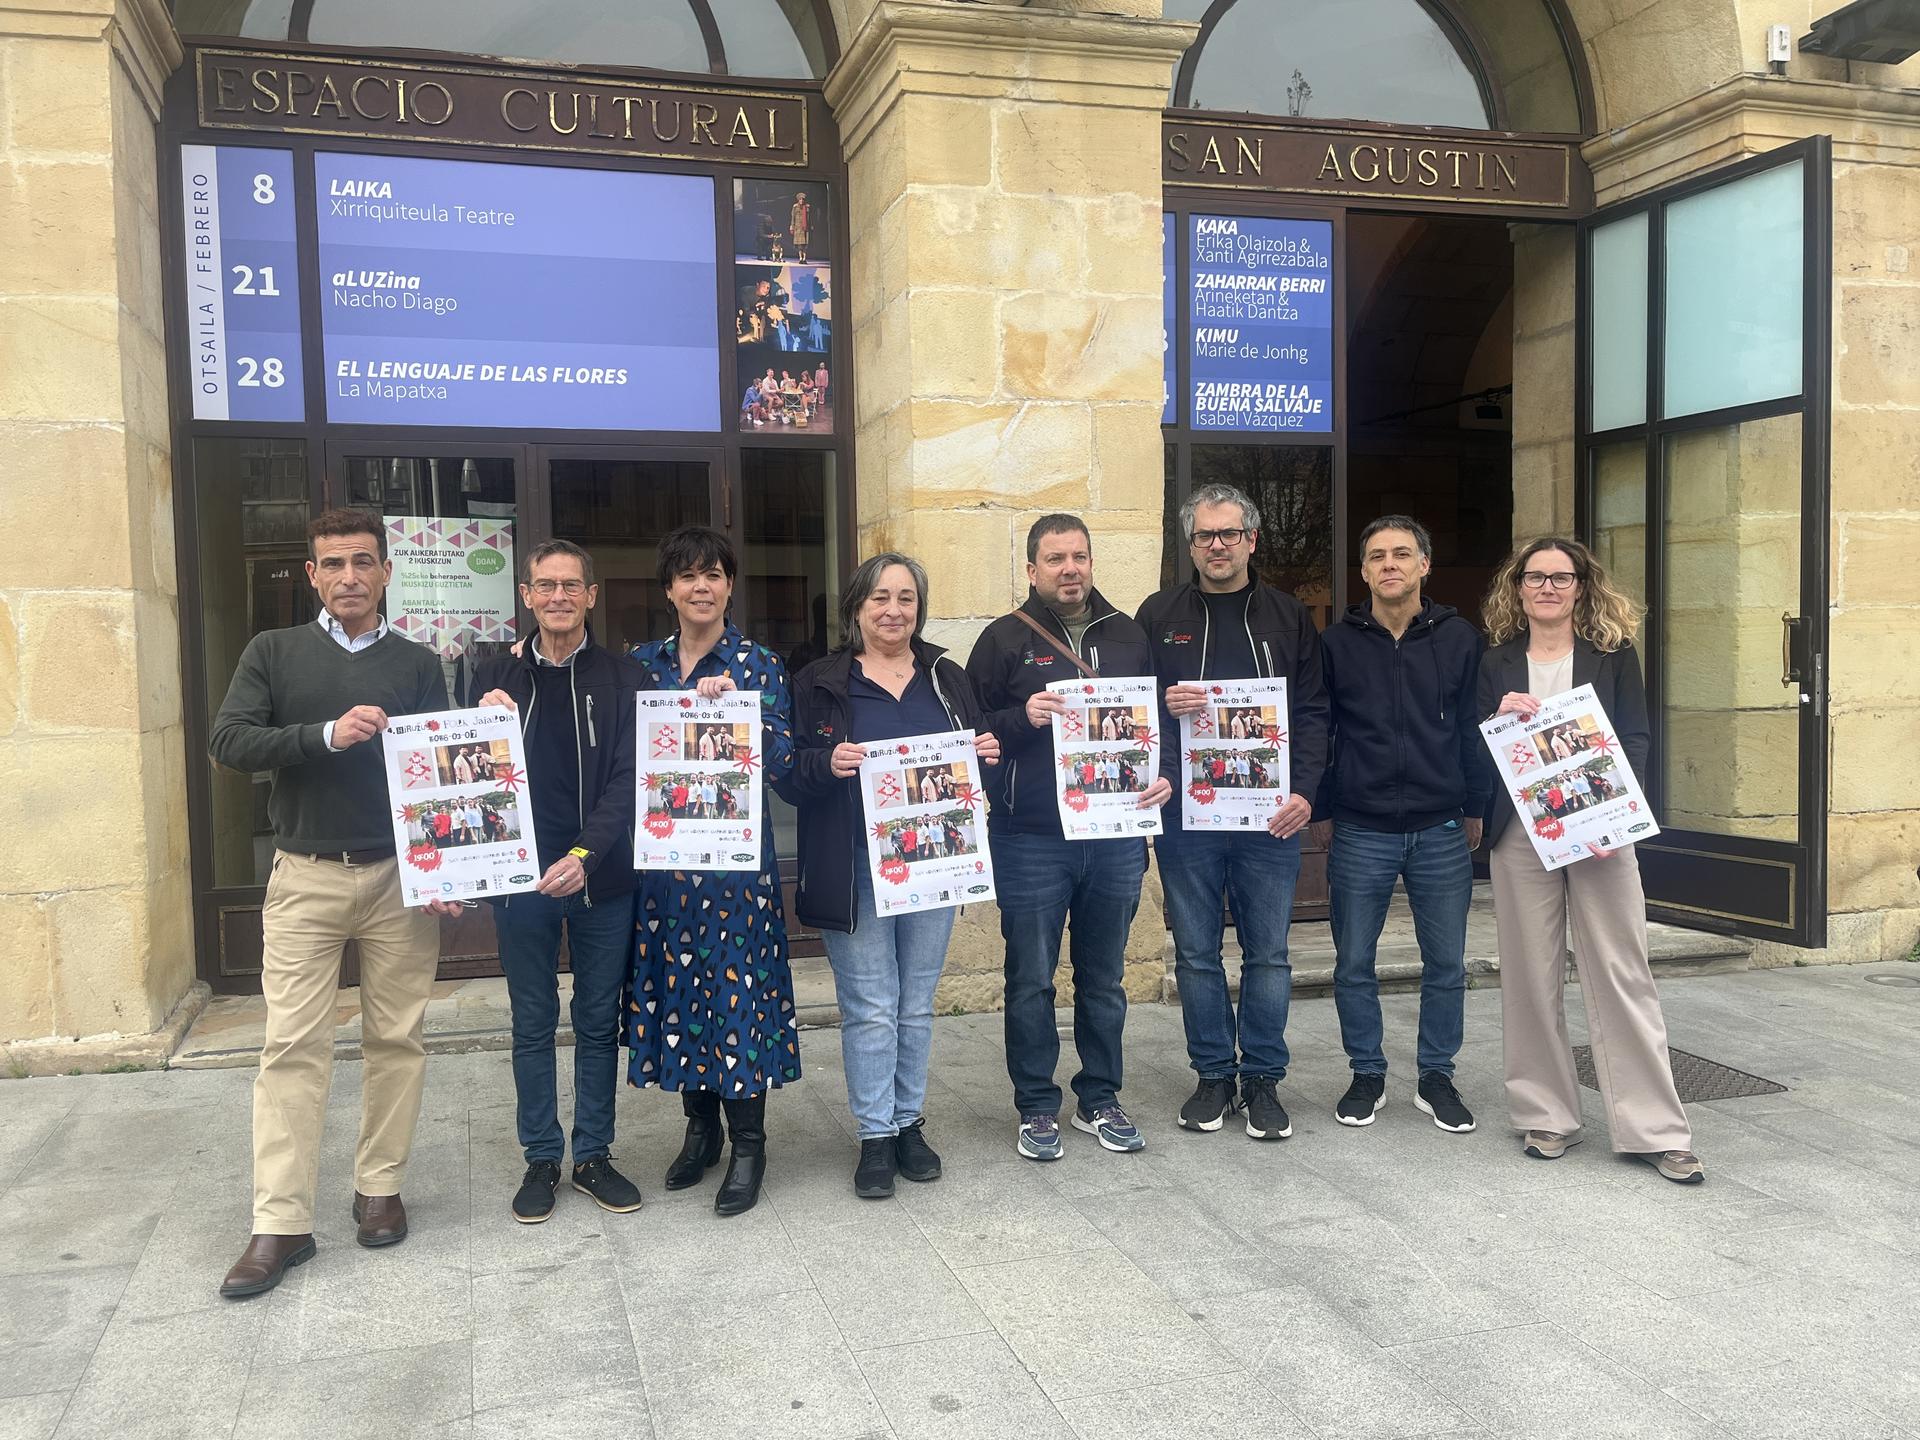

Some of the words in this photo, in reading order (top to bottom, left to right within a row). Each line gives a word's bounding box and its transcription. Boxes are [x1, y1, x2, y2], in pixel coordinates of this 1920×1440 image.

[214, 65, 454, 125] ESPACIO
[500, 88, 795, 150] CULTURAL
[1167, 132, 1264, 176] SAN
[1315, 143, 1518, 191] AGUSTIN
[252, 173, 276, 205] 8
[330, 179, 393, 199] LAIKA
[331, 199, 448, 224] Xirriquiteula
[454, 206, 515, 225] Teatre
[193, 174, 212, 273] FEBRERO
[1196, 219, 1238, 235] KAKA
[1197, 233, 1233, 250] Erika
[1237, 234, 1296, 252] Olaizola
[1300, 239, 1311, 253] &
[1196, 247, 1234, 263] Xanti
[1237, 250, 1328, 269] Agirrezabala
[231, 265, 280, 296] 21
[332, 270, 421, 290] aLUZina
[1195, 274, 1278, 291] ZAHARRAK
[1280, 279, 1326, 293] BERRI
[334, 290, 397, 308] Nacho
[403, 292, 457, 315] Diago
[1195, 288, 1274, 305] Arineketan
[1278, 291, 1289, 306] &
[1196, 303, 1244, 318] Haatik
[1249, 304, 1298, 320] Dantza
[1195, 328, 1239, 343] KIMU
[199, 302, 218, 394] OTSAILA
[1196, 342, 1236, 358] Marie
[1240, 343, 1259, 358] de
[1263, 344, 1308, 365] Jonhg
[236, 357, 285, 388] 28
[337, 360, 361, 377] EL
[368, 361, 474, 381] LENGUAJE
[480, 364, 506, 381] DE
[511, 366, 547, 383] LAS
[552, 367, 628, 385] FLORES
[338, 380, 360, 397] La
[366, 381, 447, 402] Mapatxa
[1195, 382, 1262, 398] ZAMBRA
[1265, 385, 1287, 399] DE
[1290, 385, 1309, 399] LA
[1196, 398, 1250, 412] BUENA
[1254, 399, 1322, 414] SALVAJE
[1196, 411, 1239, 426] Isabel
[1242, 410, 1304, 430] Vázquez
[410, 549, 464, 557] AUKERATUTAKO
[430, 572, 470, 581] beherapena
